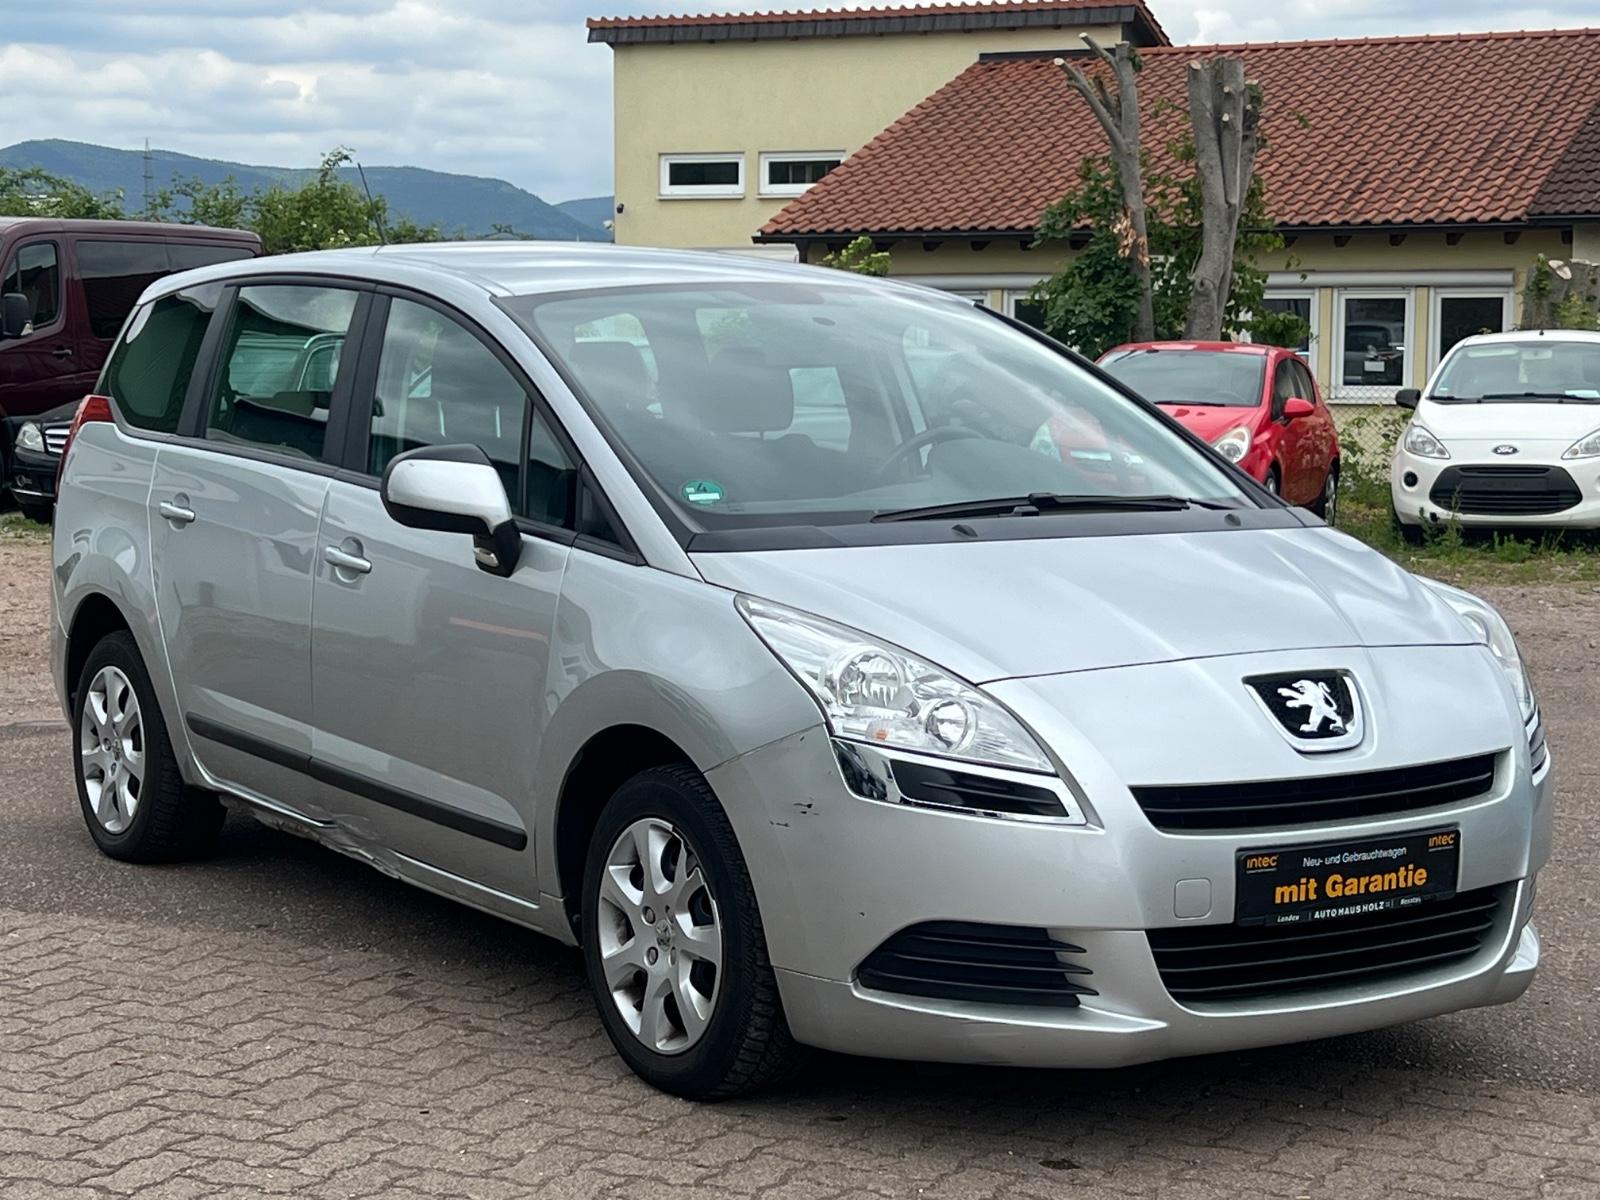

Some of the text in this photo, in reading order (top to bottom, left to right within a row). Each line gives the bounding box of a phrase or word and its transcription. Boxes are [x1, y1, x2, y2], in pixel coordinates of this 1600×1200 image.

[1428, 834, 1454, 847] intec
[1246, 855, 1278, 869] intec
[1302, 847, 1407, 867] Neu- und Gebrauchtwagen
[1274, 864, 1428, 904] mit Garantie
[1362, 901, 1385, 912] HOLZ
